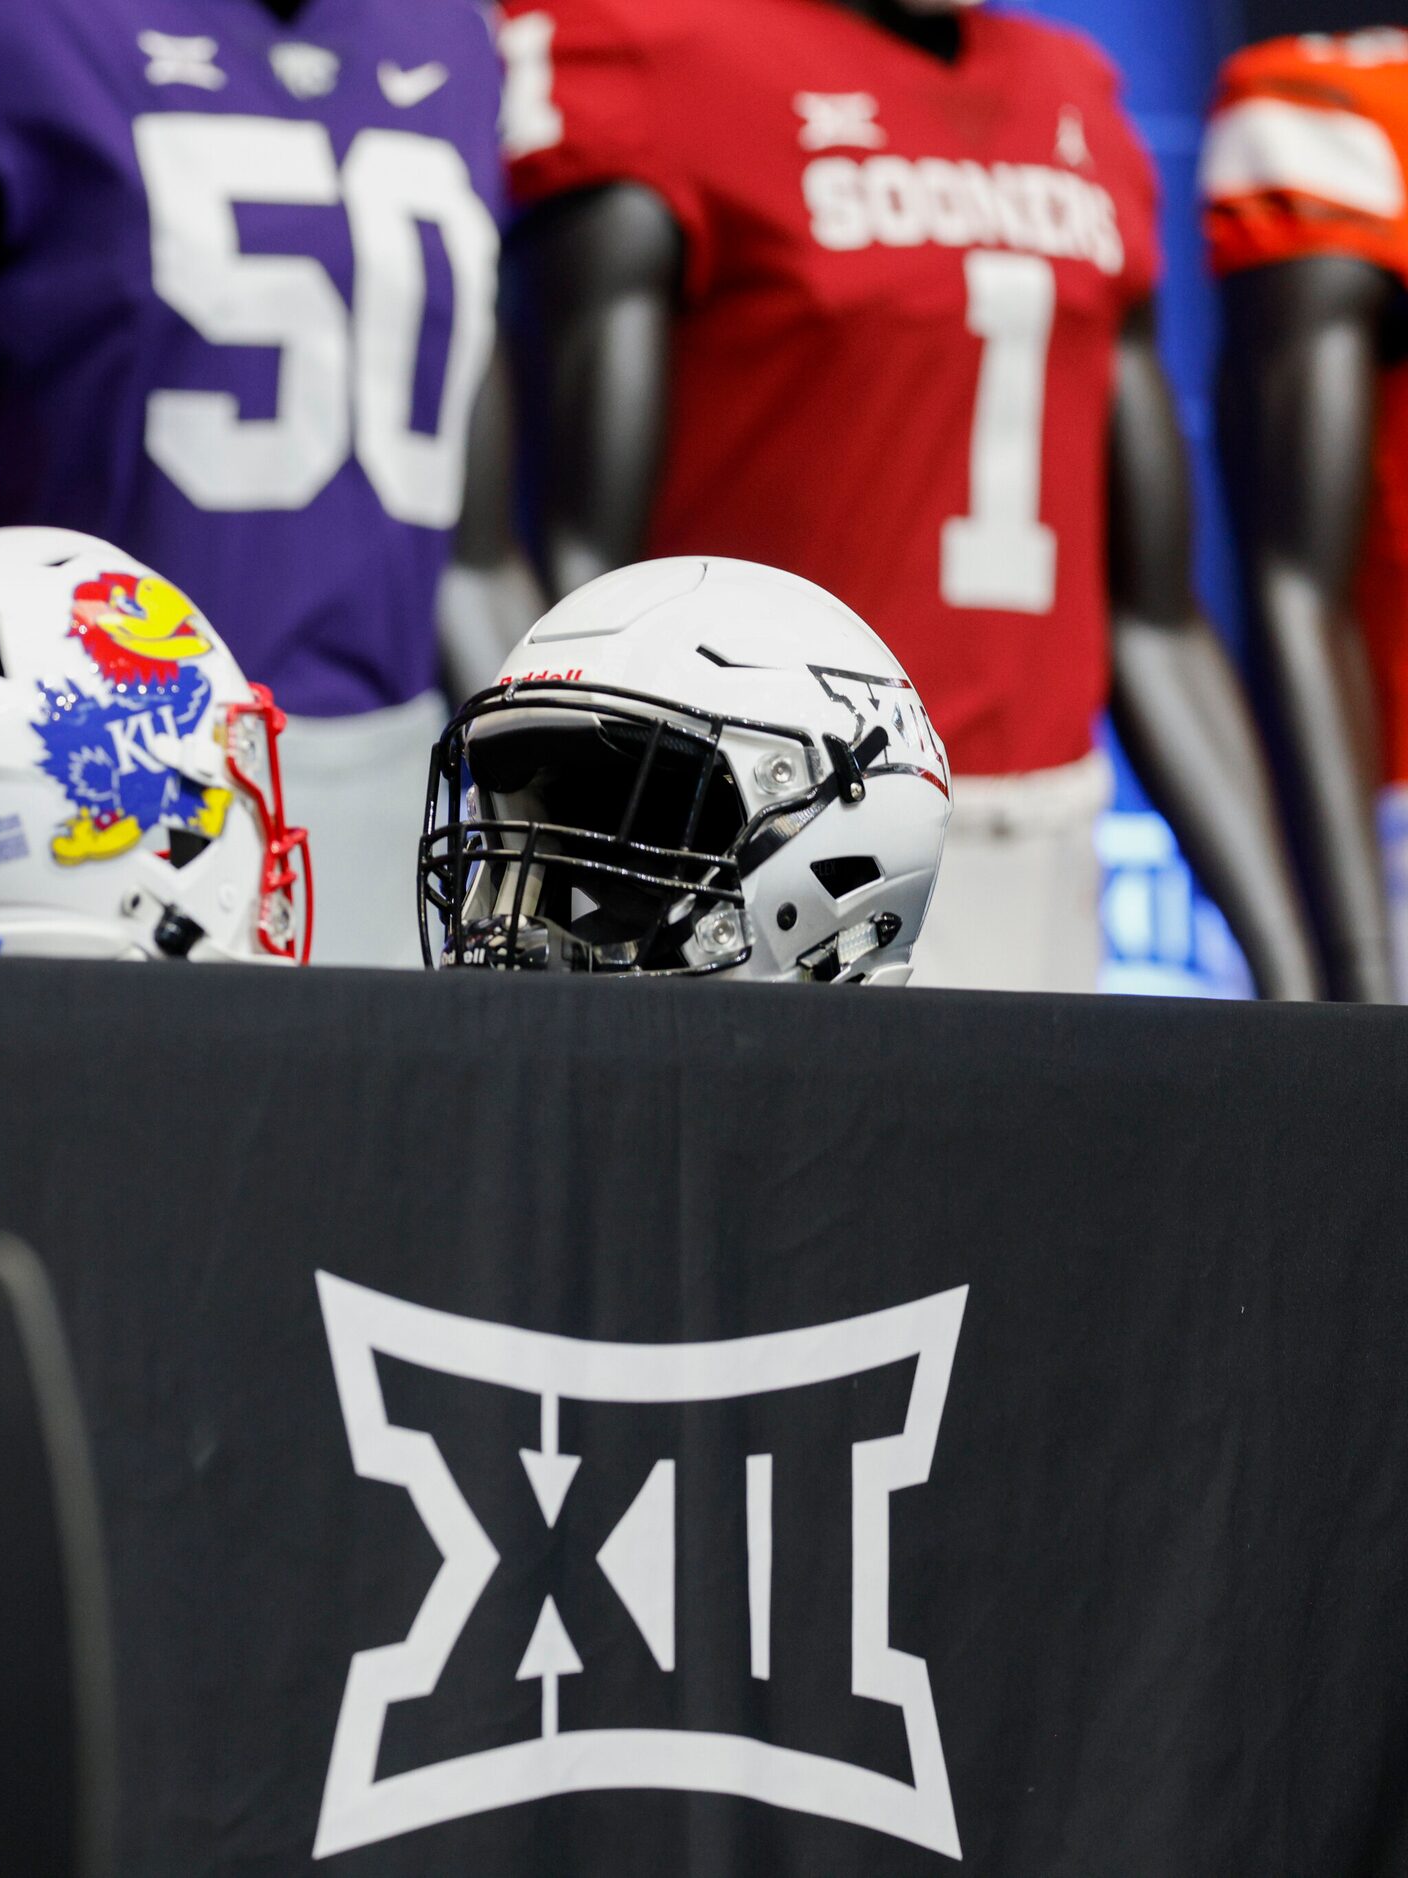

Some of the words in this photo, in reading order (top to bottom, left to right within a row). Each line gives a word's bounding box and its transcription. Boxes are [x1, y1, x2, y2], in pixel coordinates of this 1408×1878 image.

[133, 111, 500, 530] 50
[800, 154, 1125, 278] SOONERS
[939, 248, 1057, 616] 1
[103, 703, 182, 776] KU
